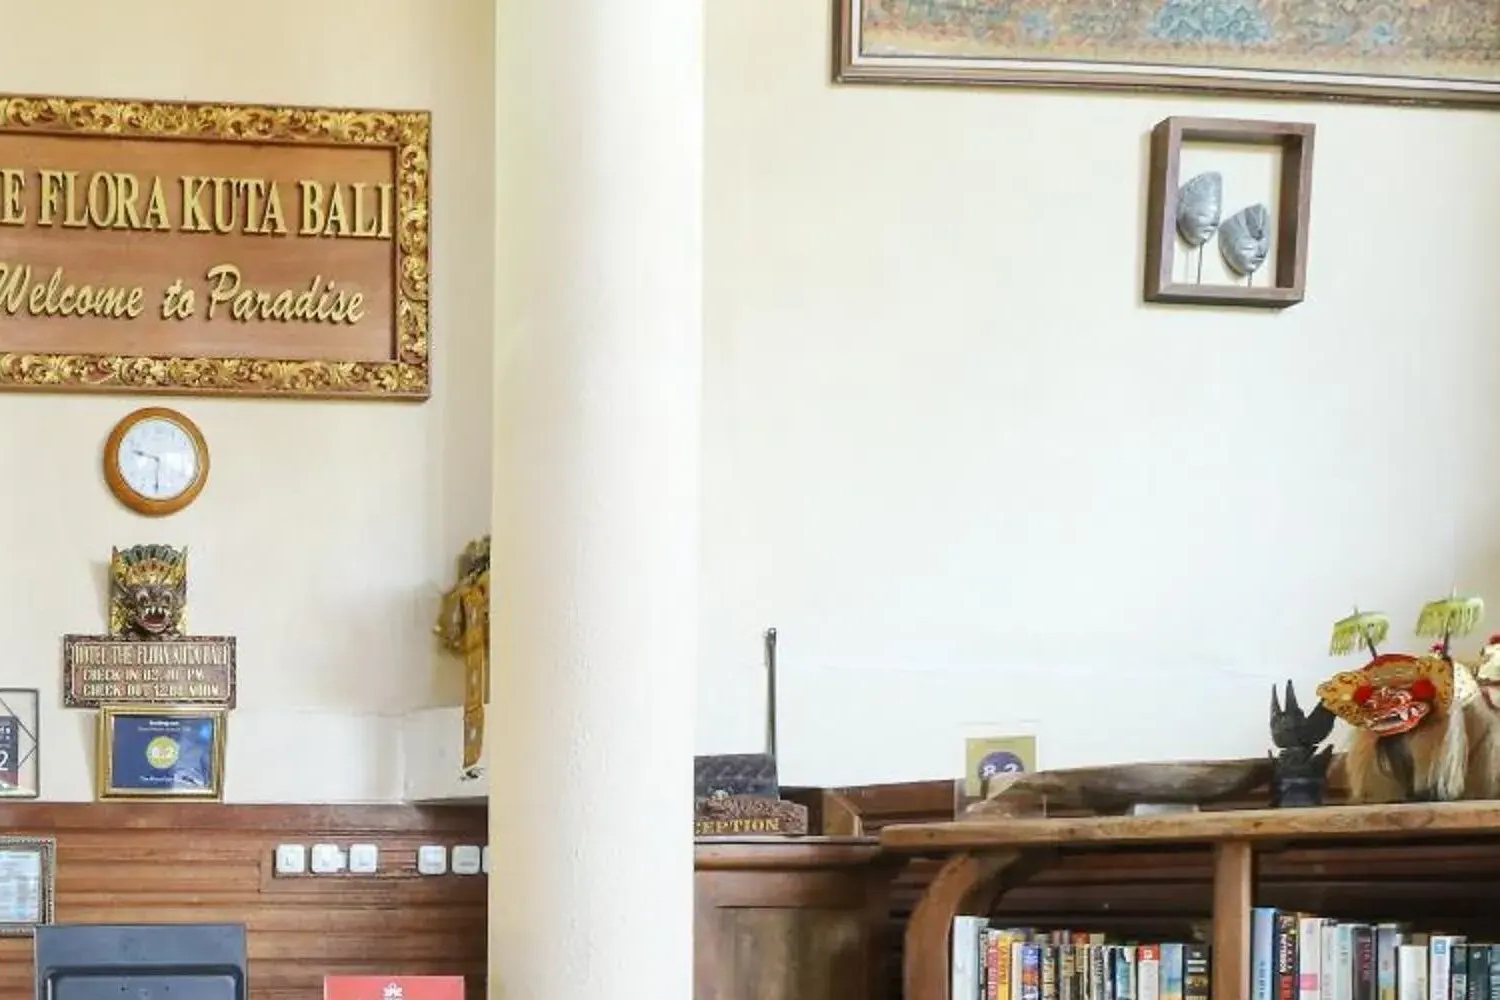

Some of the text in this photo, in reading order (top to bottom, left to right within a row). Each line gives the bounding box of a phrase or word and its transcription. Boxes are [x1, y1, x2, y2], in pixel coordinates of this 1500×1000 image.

[37, 169, 171, 232] FLORA
[181, 174, 288, 235] KUTA
[297, 179, 393, 239] BALI
[159, 278, 195, 321] to
[206, 263, 366, 323] Paradise
[83, 668, 121, 681] CHECK
[125, 668, 138, 681] IN
[83, 684, 121, 697] CHECK
[983, 762, 1019, 777] 82
